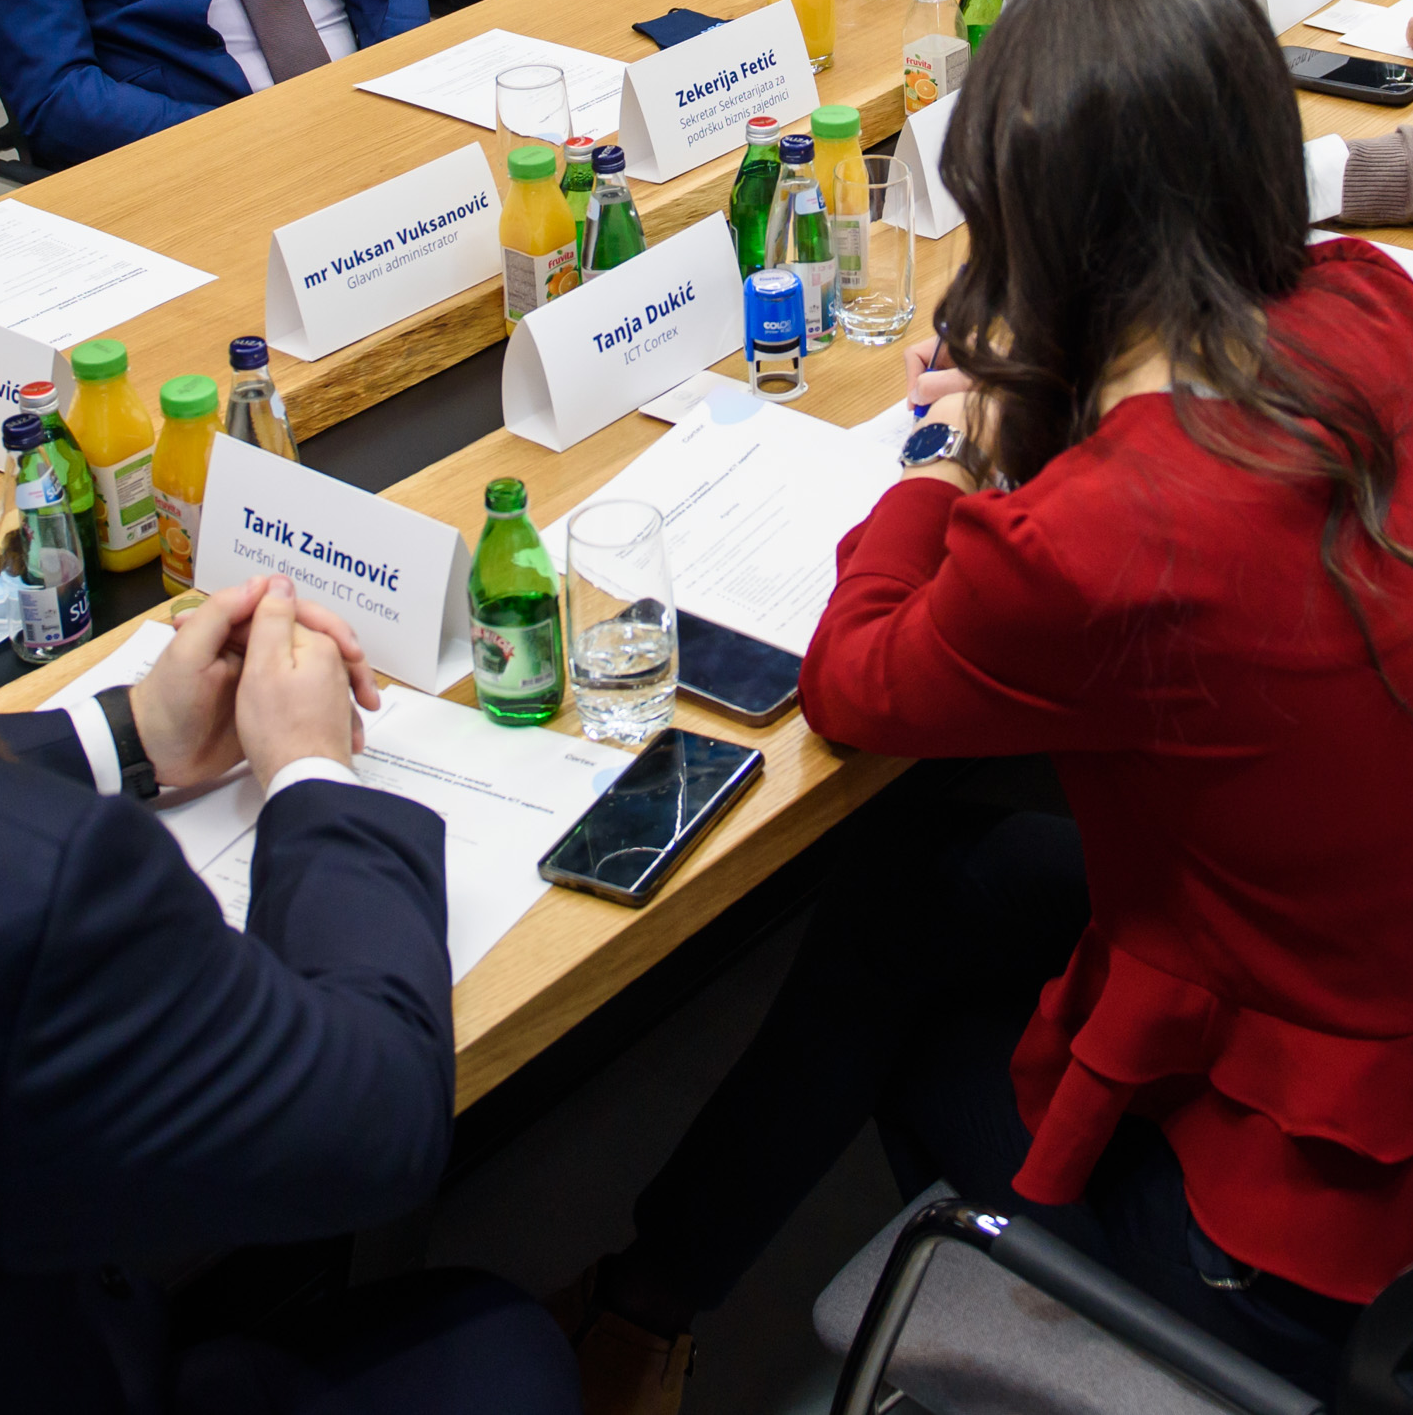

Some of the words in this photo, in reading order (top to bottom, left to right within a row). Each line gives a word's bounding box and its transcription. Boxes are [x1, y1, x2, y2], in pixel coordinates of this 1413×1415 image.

[674, 69, 740, 109] Zekerija
[739, 48, 777, 80] Fetić
[905, 57, 932, 71] Fruvita
[679, 104, 718, 130] Sekretar
[718, 79, 775, 112] Sekretarijata
[775, 73, 786, 87] za
[686, 118, 725, 148] podršku
[724, 106, 751, 127] biznis
[751, 87, 790, 115] zajednici
[303, 267, 329, 290] mr
[330, 237, 396, 276] Vuksan
[395, 190, 490, 246] Vuksanović
[346, 263, 384, 290] Glavni
[384, 229, 460, 274] administrator
[547, 250, 575, 270] Fruvita
[592, 316, 643, 354] Tanja
[644, 280, 696, 326] Dukić
[623, 344, 641, 365] ICT
[643, 325, 680, 353] Cortex
[243, 506, 295, 548] Tarik
[299, 531, 401, 592] Zaimović
[70, 600, 90, 622] SU
[233, 538, 276, 569] Izvršni
[277, 558, 330, 592] direktor
[331, 580, 355, 602] ICT
[356, 592, 401, 624] Cortex
